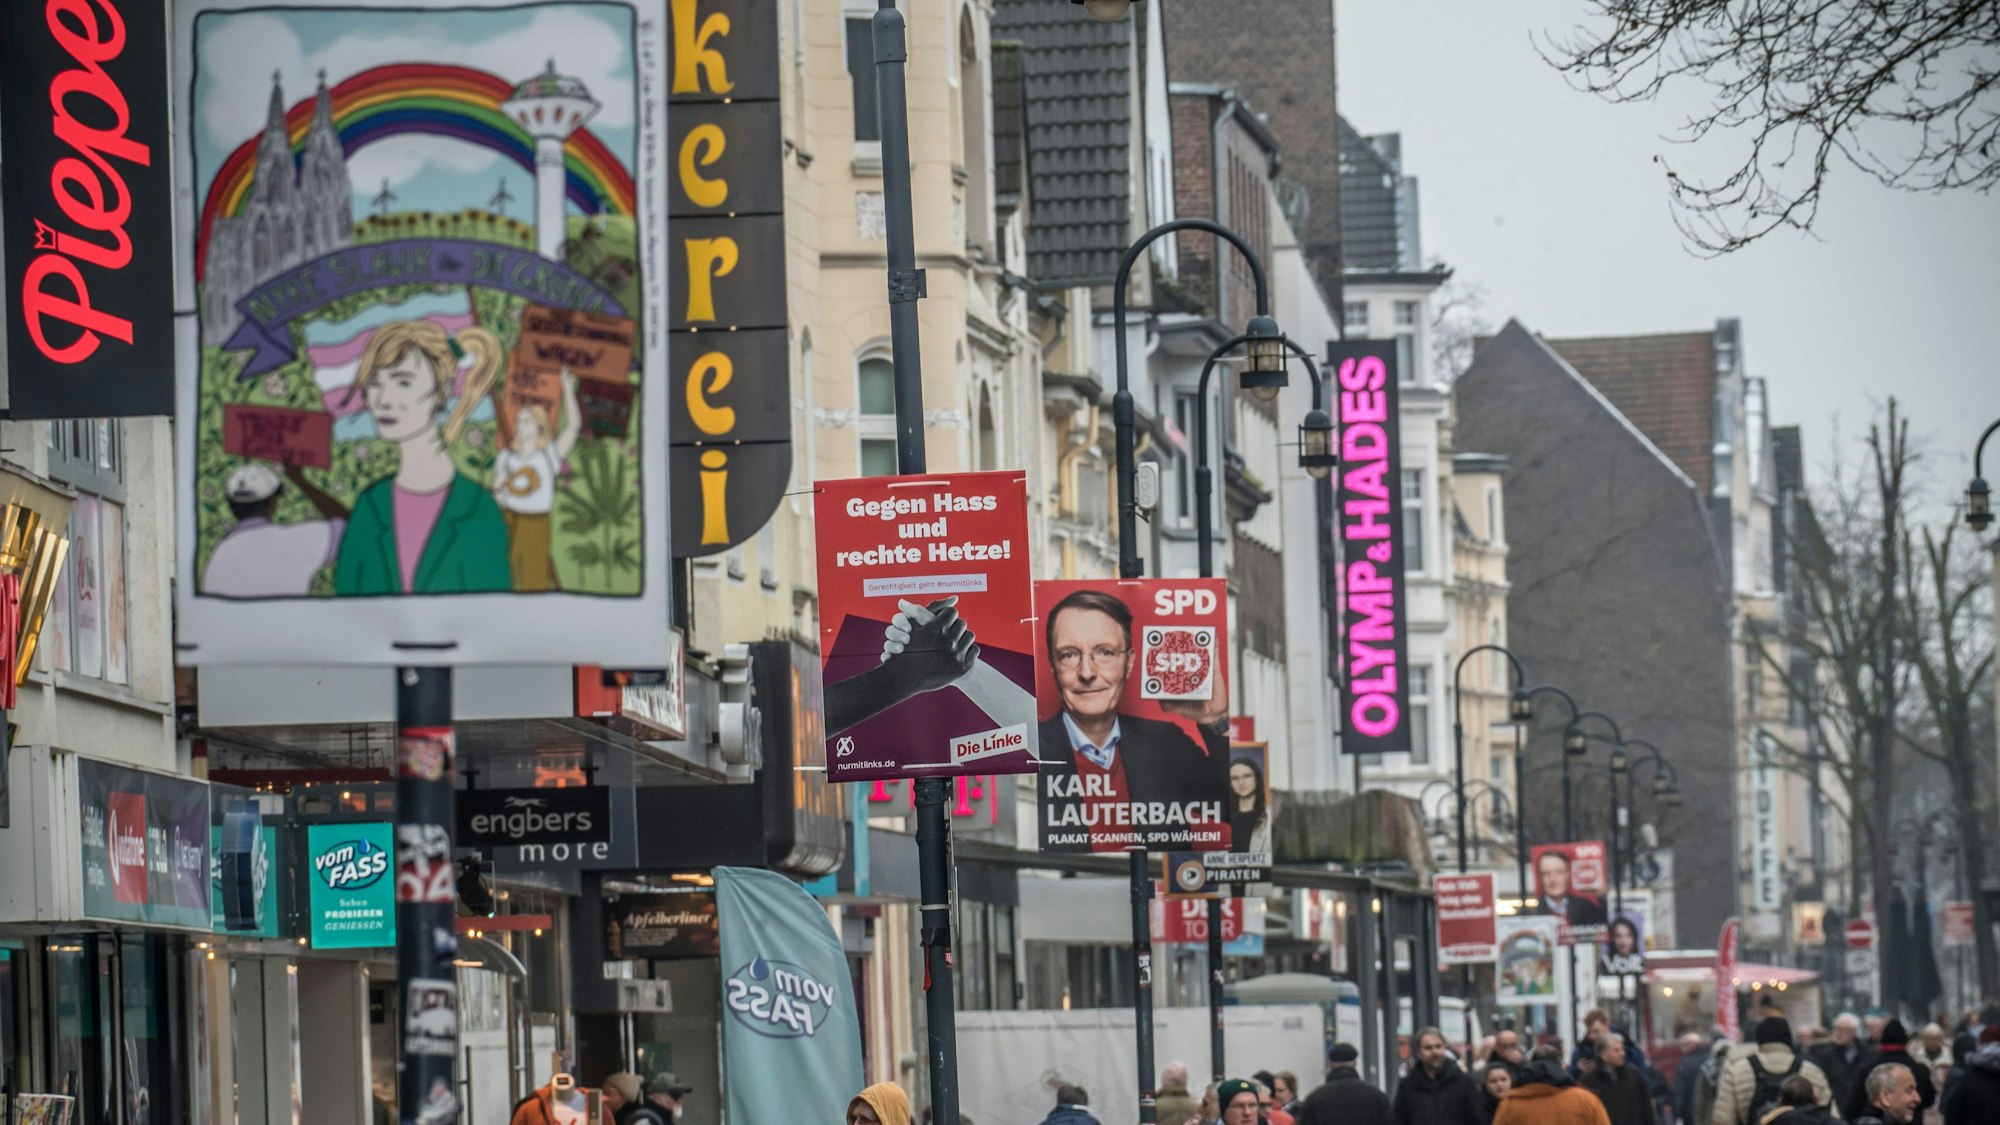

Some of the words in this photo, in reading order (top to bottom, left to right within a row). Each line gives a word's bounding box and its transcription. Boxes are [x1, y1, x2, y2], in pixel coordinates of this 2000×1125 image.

[846, 495, 927, 521] Gegen
[933, 492, 998, 513] Hass
[898, 516, 948, 539] und
[836, 544, 922, 568] rechte
[928, 539, 1011, 563] Hetze!
[868, 581, 917, 592] Gerechtigkeit
[918, 580, 935, 590] geht
[937, 578, 983, 588] #nurmitlinks
[1154, 588, 1217, 616] SPD
[1155, 652, 1202, 673] SPD
[956, 740, 981, 758] Die
[983, 732, 1022, 752] Linke
[837, 759, 896, 771] nurmitlinks.de
[1046, 773, 1117, 798] KARL
[471, 807, 593, 838] engbers
[1047, 800, 1221, 827] LAUTERBACH
[1048, 833, 1089, 844] PLAKAT
[1091, 832, 1146, 845] SCANNEN,
[1147, 832, 1169, 843] SPD
[1170, 830, 1221, 842] WÄHLEN!
[315, 846, 354, 870] vom
[519, 842, 608, 863] more
[1206, 854, 1226, 864] ANNE
[329, 852, 387, 888] FASS
[1206, 868, 1261, 881] PIRATEN
[324, 909, 384, 919] PROBIEREN
[624, 910, 712, 929] Apfelberliner
[324, 921, 384, 931] GENIESSEN
[1183, 920, 1235, 939] TOR
[1602, 952, 1644, 974] Volt
